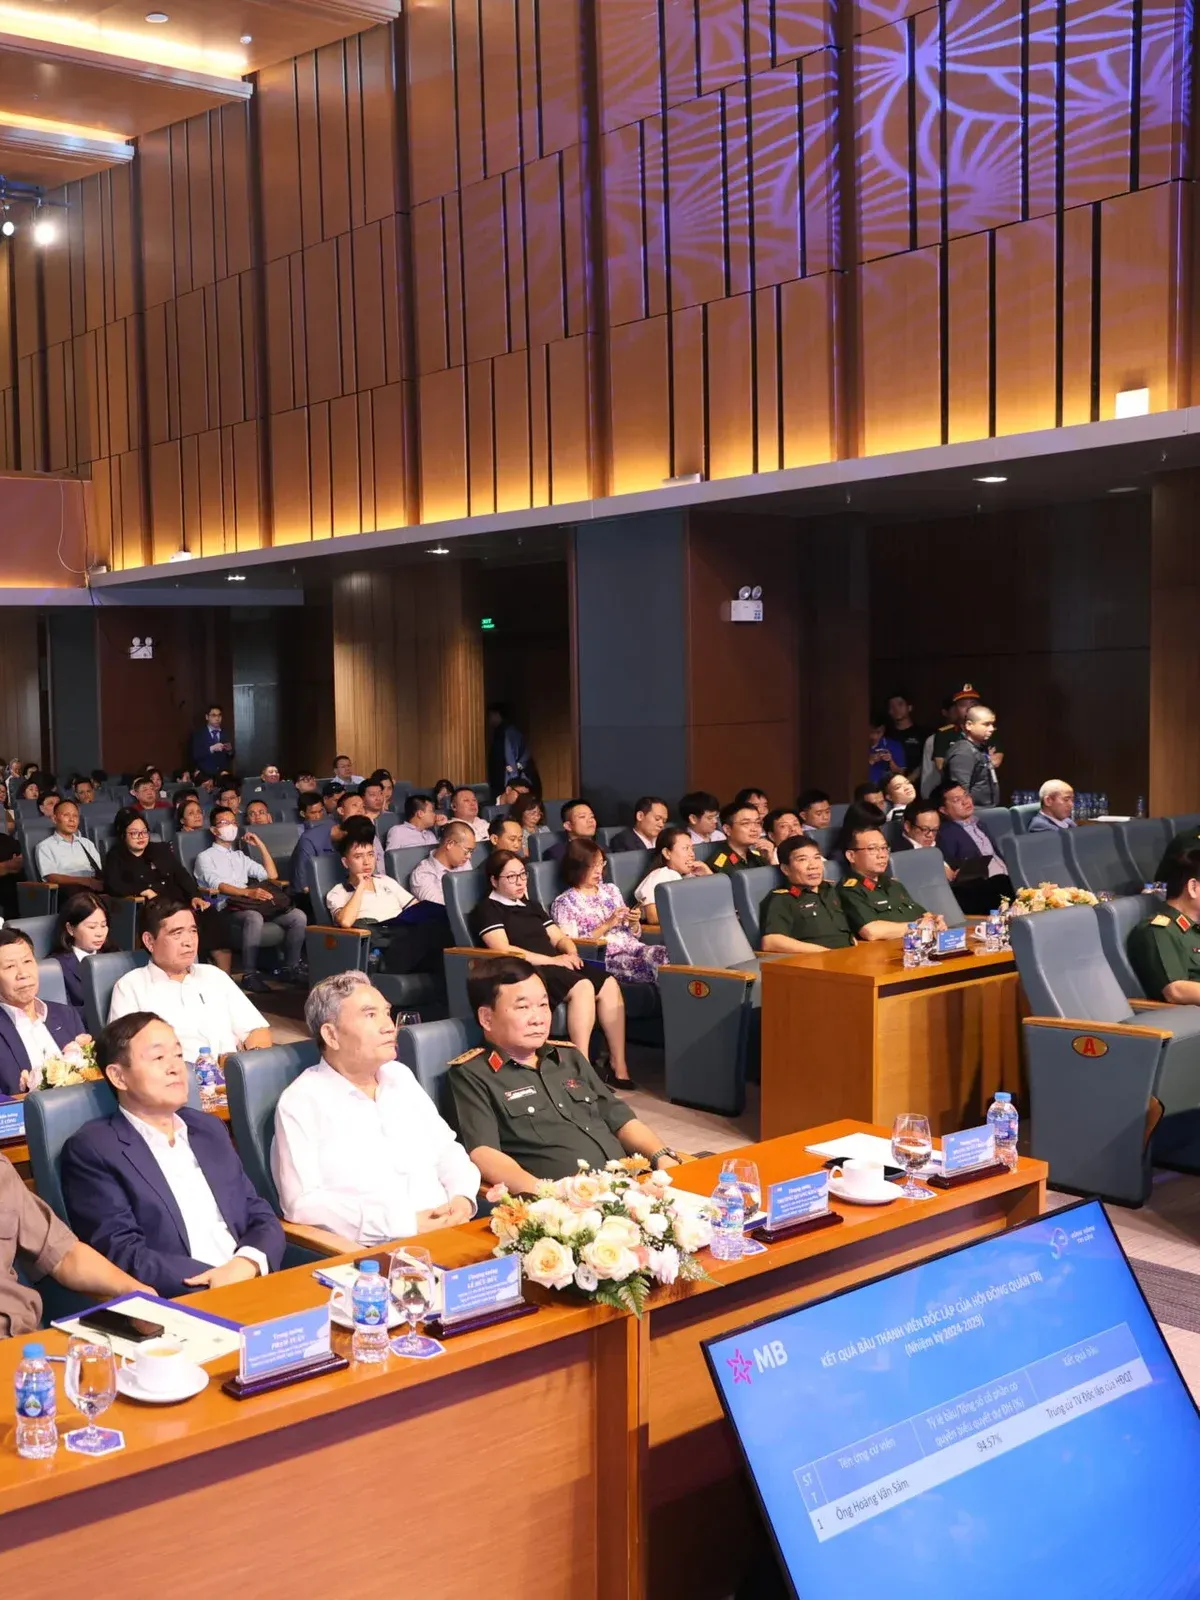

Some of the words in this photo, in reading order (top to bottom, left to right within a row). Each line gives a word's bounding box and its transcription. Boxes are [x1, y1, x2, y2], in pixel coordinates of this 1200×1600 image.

[1082, 1037, 1097, 1055] A
[820, 1349, 838, 1368] KẾT
[837, 1342, 858, 1362] QUẢ
[857, 1336, 877, 1356] BẦU
[876, 1325, 905, 1347] THÀNH
[905, 1318, 925, 1335] VIÊN
[956, 1296, 973, 1313] CỦA
[1008, 1276, 1031, 1293] QUẢN
[753, 1340, 788, 1373] MB
[835, 1506, 854, 1520] Ông
[852, 1494, 879, 1514] Hoàng
[877, 1486, 894, 1501] Văn
[817, 1518, 824, 1530] 1
